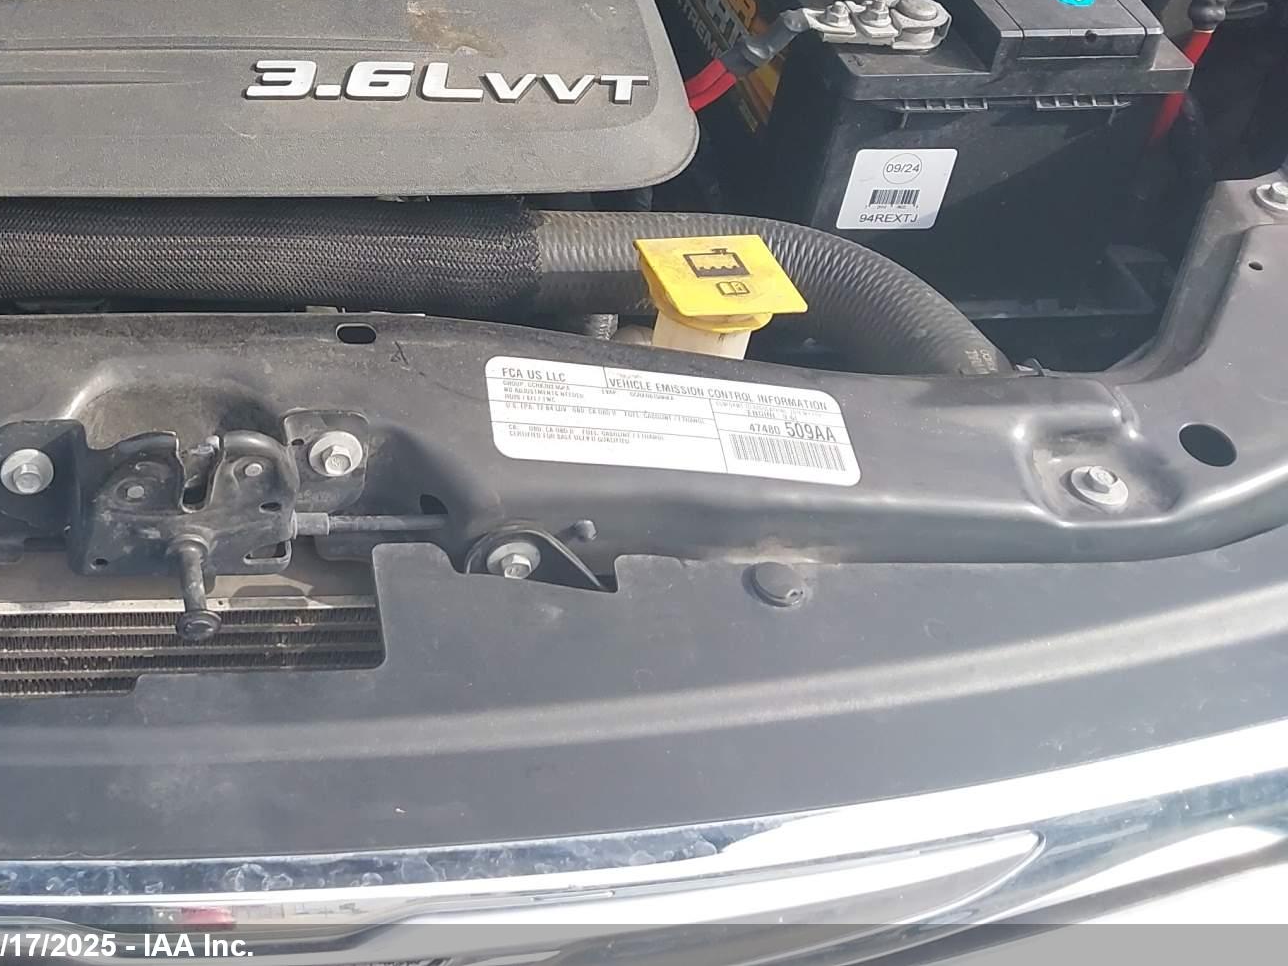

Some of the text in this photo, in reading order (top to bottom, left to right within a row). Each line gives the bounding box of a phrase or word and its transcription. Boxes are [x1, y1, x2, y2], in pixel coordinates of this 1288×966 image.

[483, 71, 650, 104] VVT
[886, 164, 920, 173] 09/24
[859, 213, 919, 223] 94REXTJ
[502, 367, 566, 382] FCA US LLC
[609, 378, 652, 392] VEHICLE
[655, 383, 704, 397] EMISSION
[707, 388, 753, 403] CONTROL
[757, 394, 827, 411] INFORMATION
[784, 421, 837, 442] 509AA
